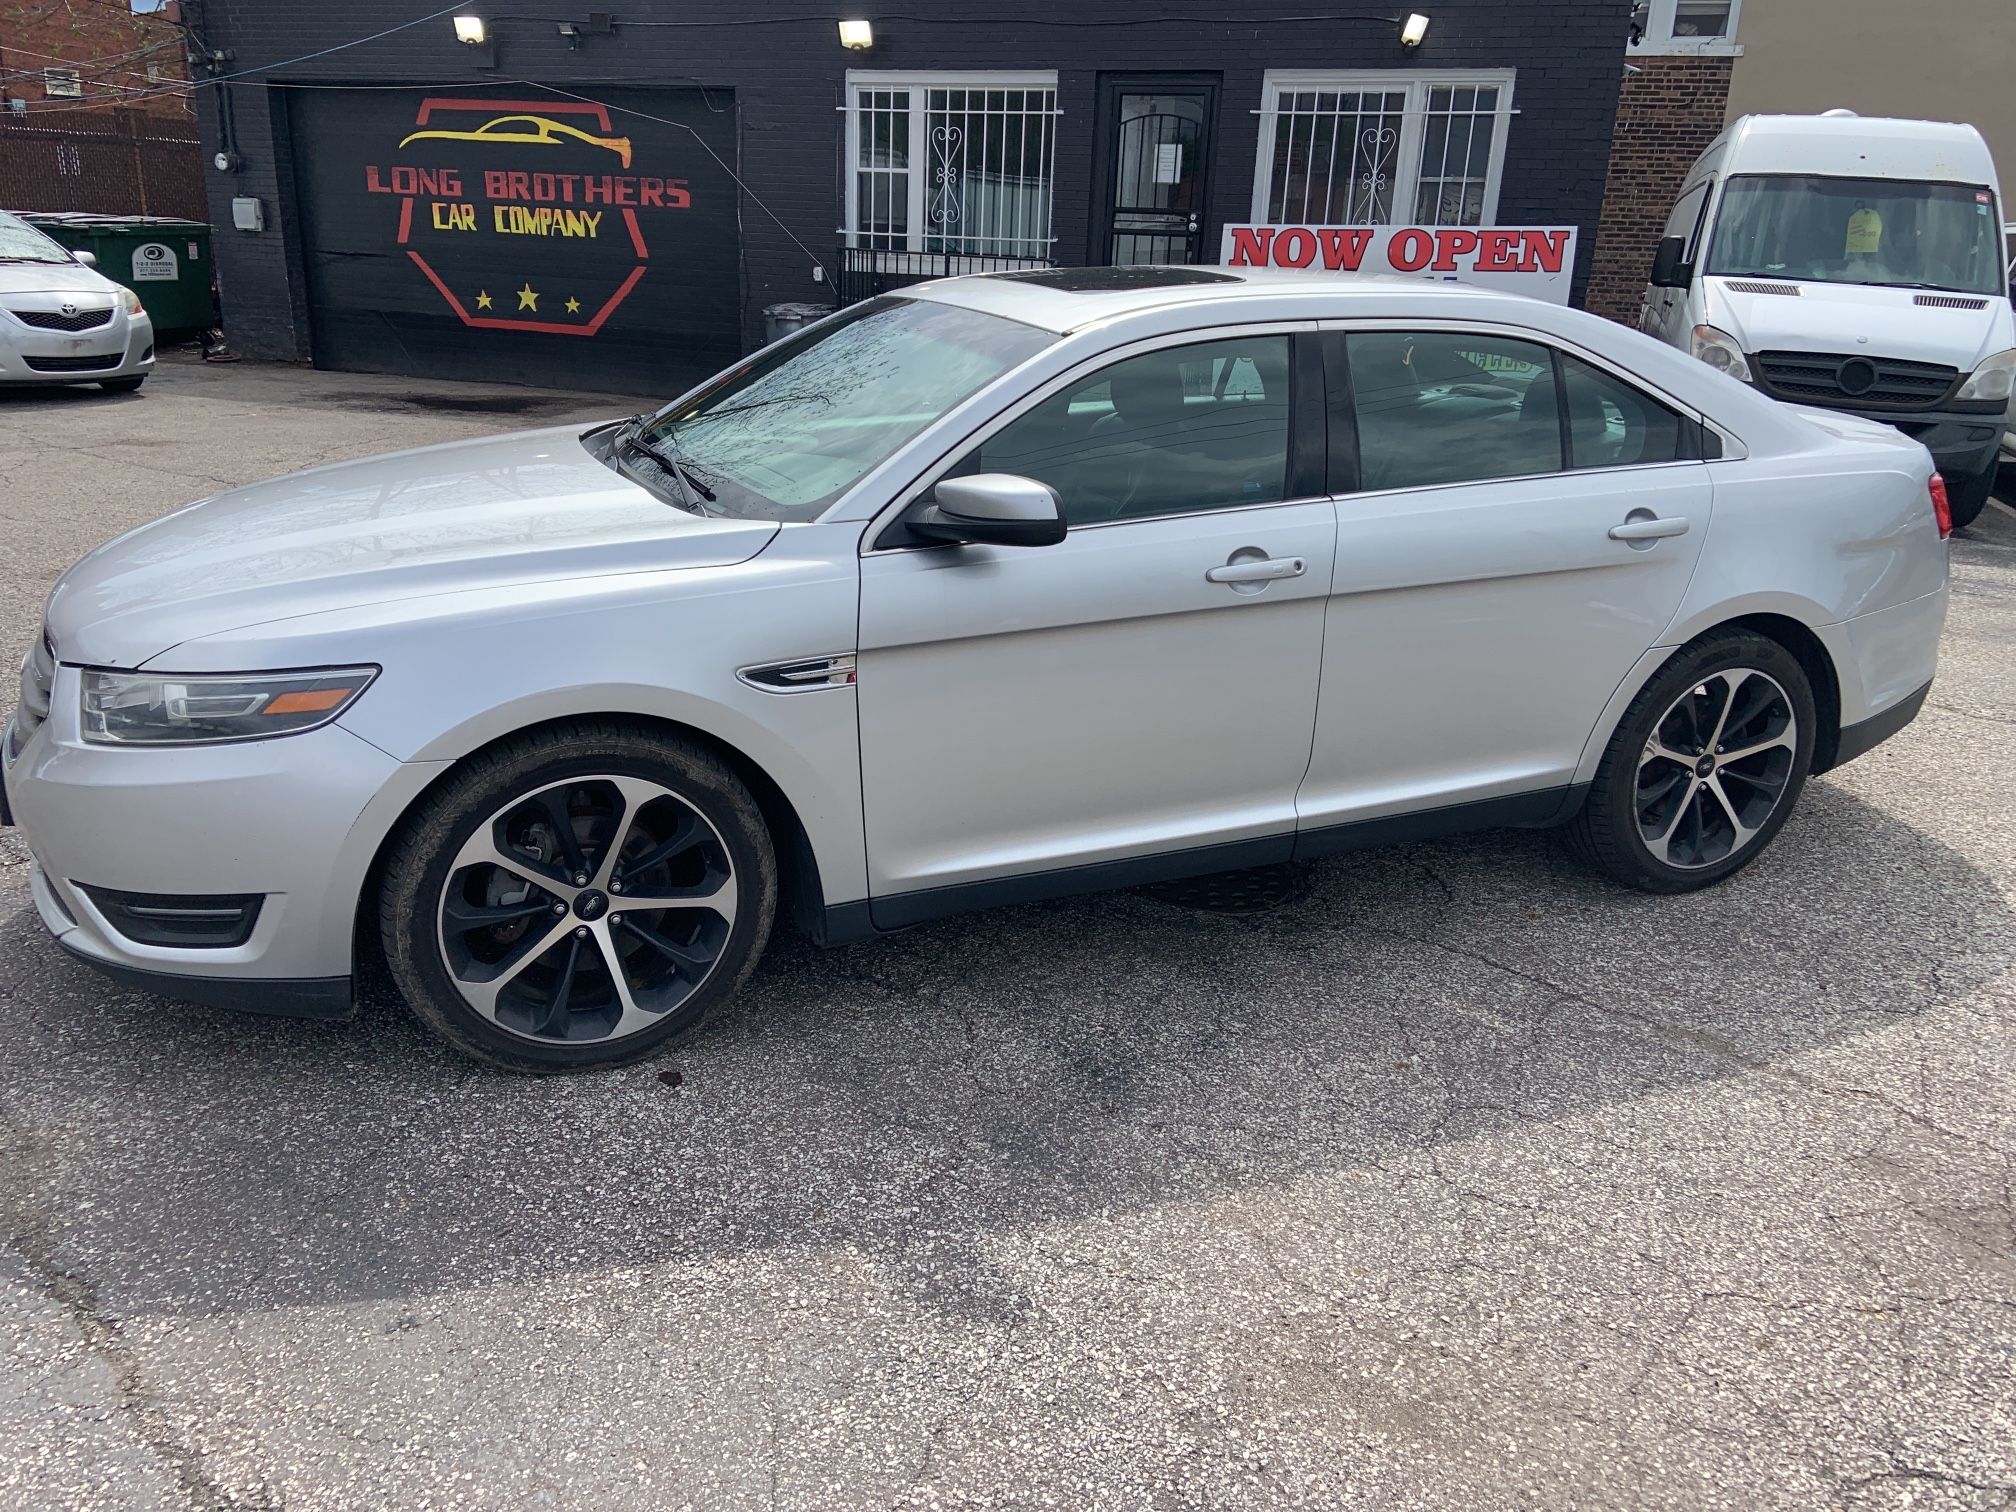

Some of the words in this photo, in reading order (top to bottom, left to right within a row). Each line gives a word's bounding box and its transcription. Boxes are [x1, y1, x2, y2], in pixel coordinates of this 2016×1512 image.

[366, 165, 462, 197] LONG
[484, 170, 691, 209] BROTHERS
[432, 202, 478, 232] CAR
[493, 205, 602, 238] COMPANY
[1228, 227, 1374, 271] NOW
[1387, 228, 1570, 272] OPEN
